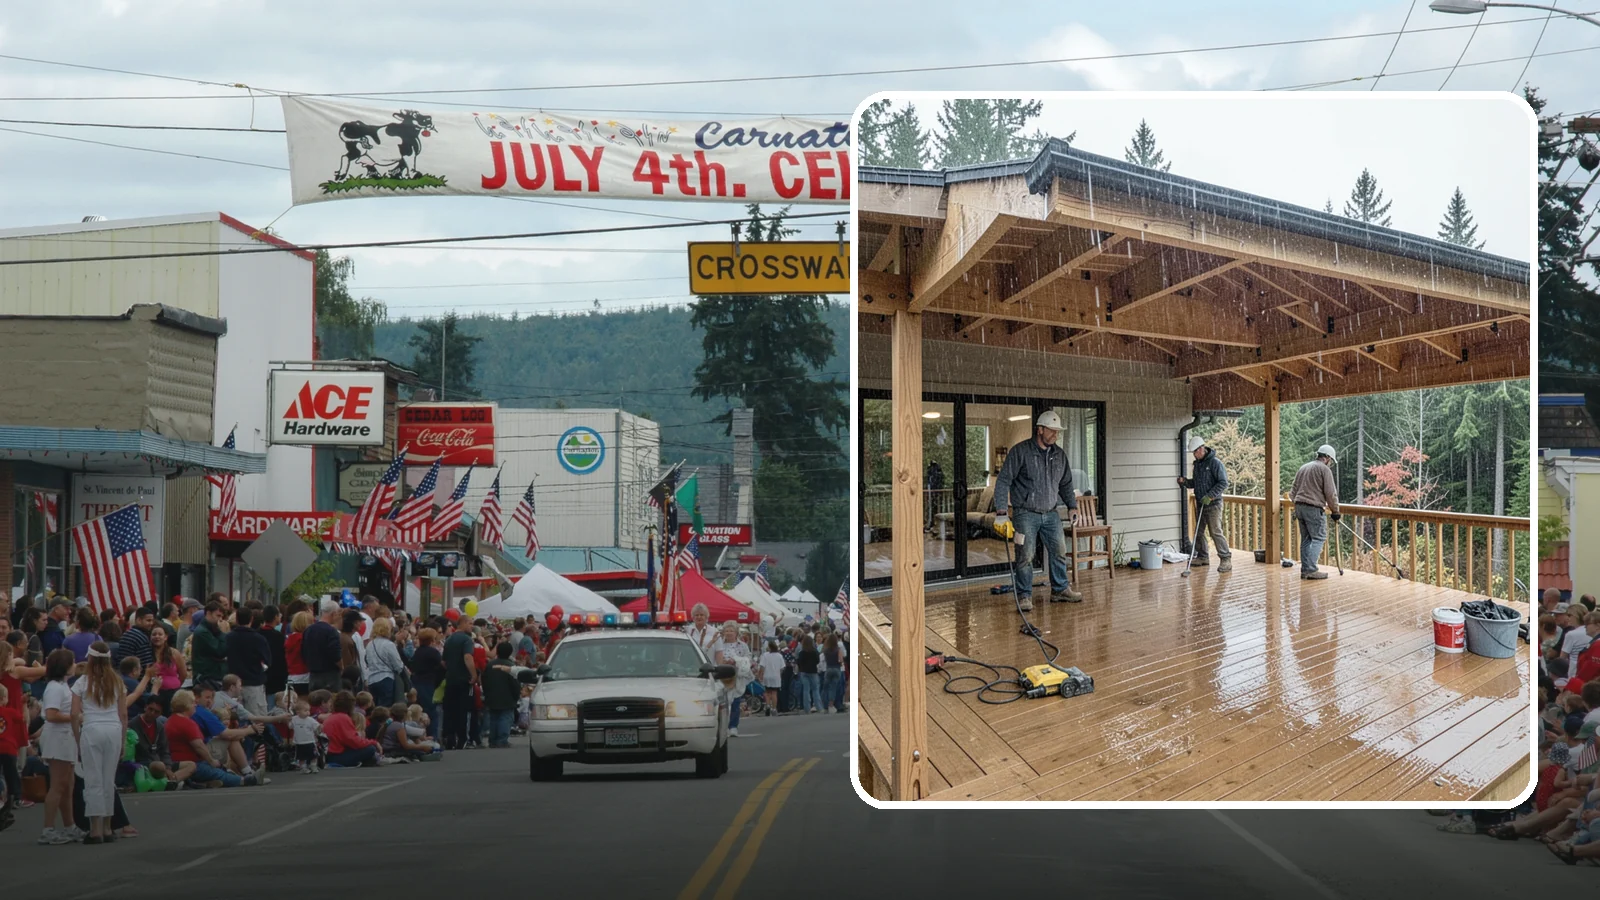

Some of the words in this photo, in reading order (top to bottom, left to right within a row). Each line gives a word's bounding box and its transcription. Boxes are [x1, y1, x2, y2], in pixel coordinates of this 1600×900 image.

[481, 141, 604, 191] JULY
[632, 150, 746, 198] 4th.
[697, 254, 850, 280] CROSSWA
[283, 380, 373, 420] ACE
[405, 409, 453, 422] CEDAR
[284, 421, 371, 436] Hardware
[416, 428, 477, 447] Coca-Cola
[83, 485, 93, 494] St.
[96, 485, 124, 494] Vincent
[126, 486, 136, 494] de
[138, 486, 155, 495] Paul
[688, 526, 741, 535] CRNATION
[699, 535, 730, 543] GLASS
